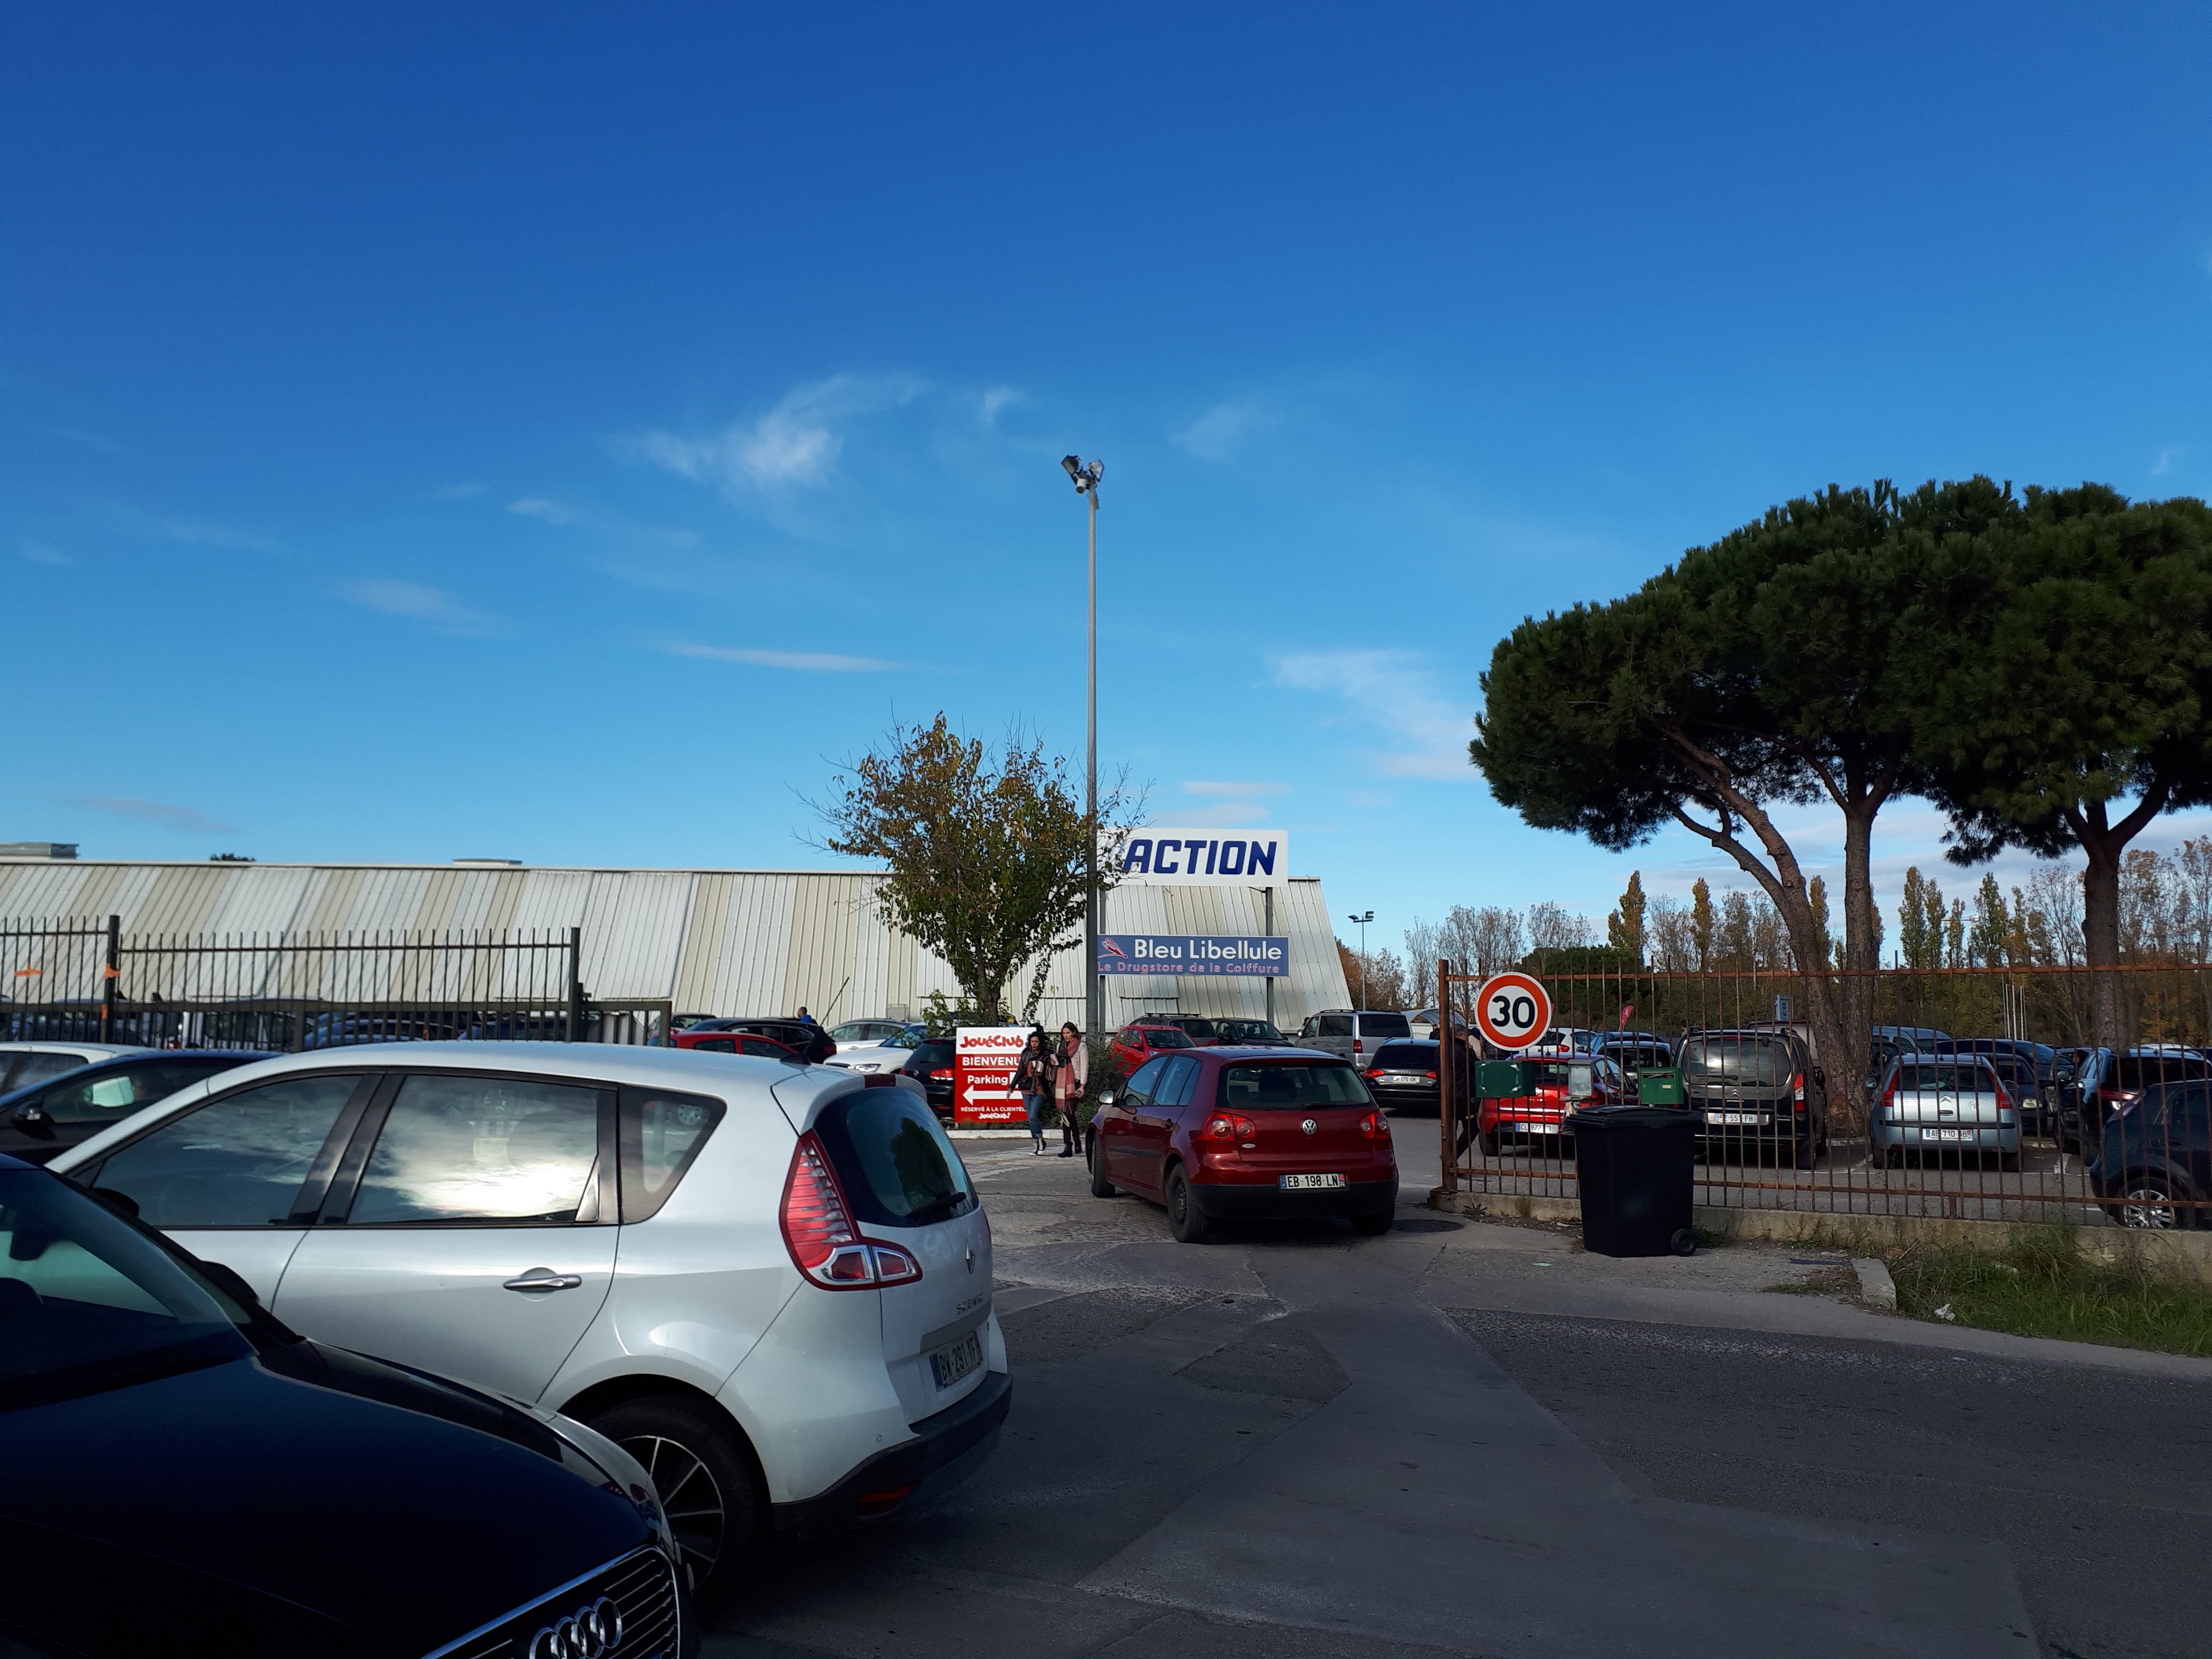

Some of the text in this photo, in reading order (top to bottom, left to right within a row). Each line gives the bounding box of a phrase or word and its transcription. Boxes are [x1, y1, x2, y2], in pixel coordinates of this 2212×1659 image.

[1121, 839, 1277, 876] ACTION
[1135, 939, 1282, 960] Bleu Libellule
[1097, 962, 1279, 974] Le Drugstore de la Coiffure
[1491, 995, 1535, 1028] 30
[962, 1057, 1021, 1066] BIENVENU
[967, 1075, 1009, 1085] Parking
[1287, 1175, 1338, 1188] EB-198-LN
